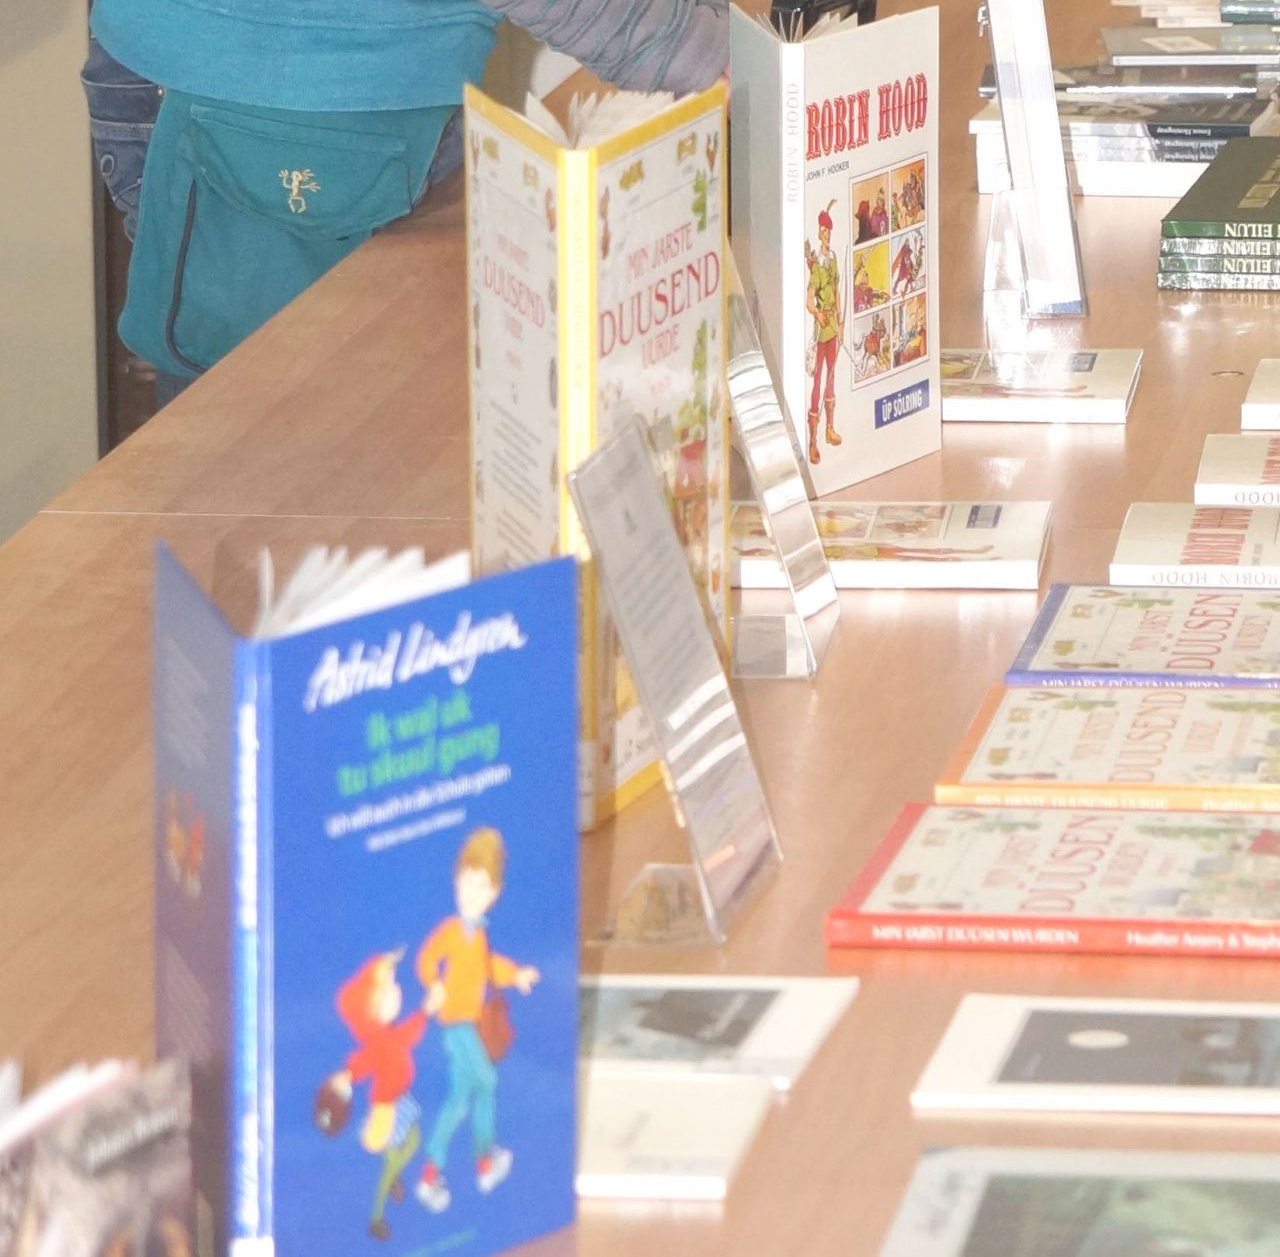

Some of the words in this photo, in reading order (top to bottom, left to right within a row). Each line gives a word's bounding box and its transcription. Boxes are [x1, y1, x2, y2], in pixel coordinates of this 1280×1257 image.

[806, 89, 871, 162] ROBIN
[877, 72, 928, 142] HOOD
[1157, 125, 1192, 136] Hemingway
[1192, 128, 1211, 137] Ernest
[806, 168, 821, 182] JOHN
[1224, 222, 1273, 238] EILUN
[1223, 258, 1272, 273] EILUN
[599, 251, 721, 359] DUUSEND
[882, 398, 893, 423] ÜP
[1151, 571, 1208, 585] HOOD
[1219, 573, 1279, 586] ROBIN
[303, 630, 402, 714] Astrid
[396, 609, 529, 685] Lindgren
